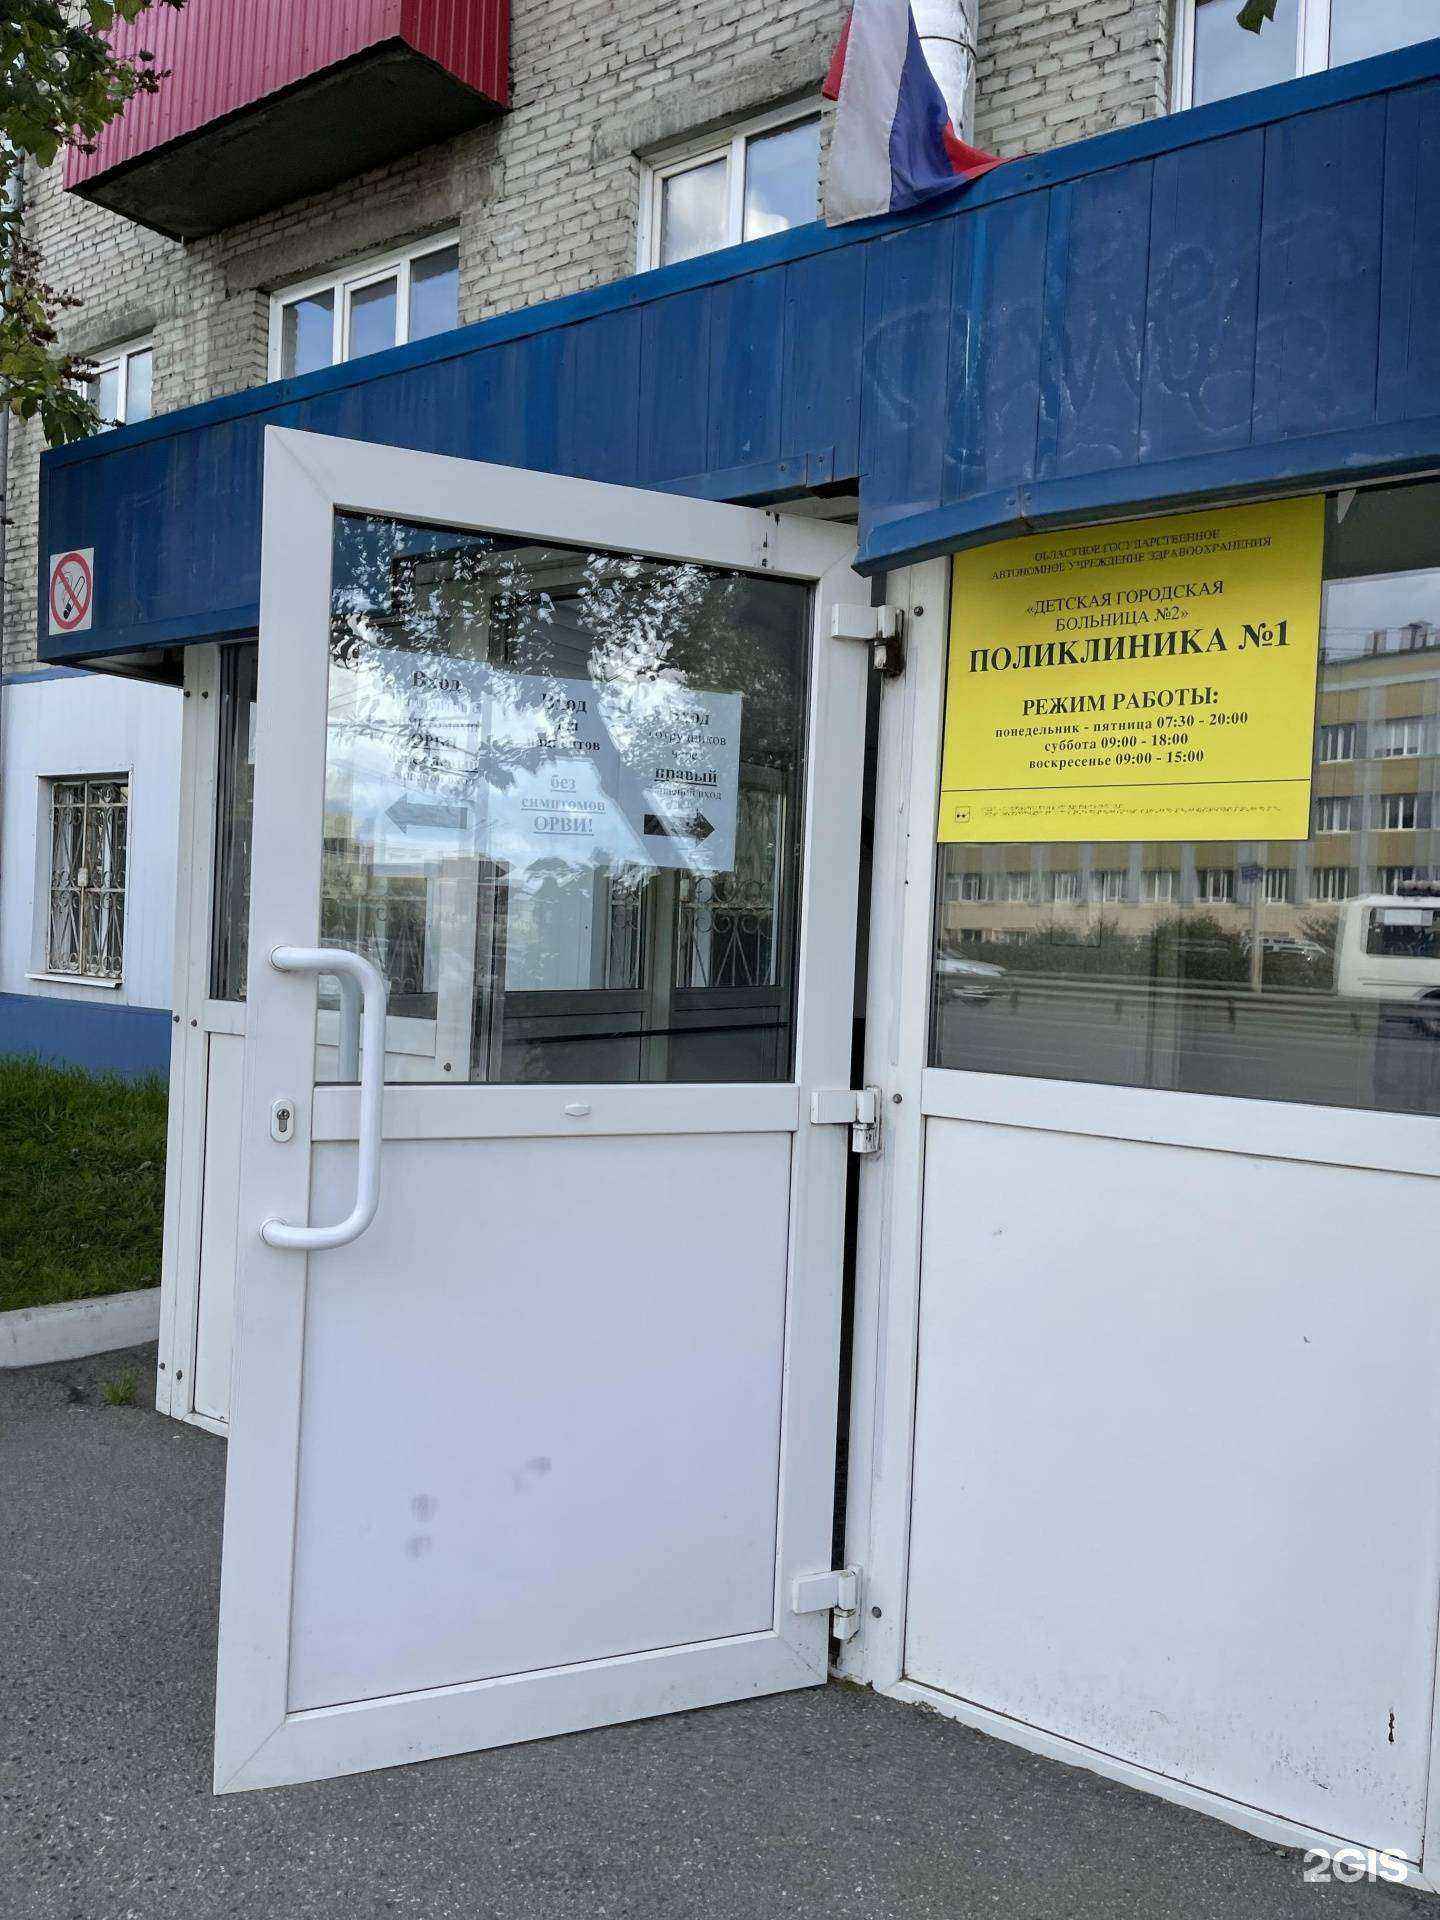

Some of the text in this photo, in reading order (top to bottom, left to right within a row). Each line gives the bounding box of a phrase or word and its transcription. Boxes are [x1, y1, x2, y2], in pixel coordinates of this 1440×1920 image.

[991, 536, 1272, 581] АВТОНОМНОЕ УЧРЕЖДЕНИЕ ЗДРАВООХРАНЕНИЯ
[1034, 529, 1220, 561] ОБЛАСТНОЕ ГОСУДАРСТВЕННОЕ
[1026, 580, 1224, 615] «ДЕТСКАЯ ГОРОДСКАЯ
[1055, 605, 1190, 633] БОЛЬНИЦА №2»
[968, 619, 1291, 673] ПОЛИКЛИНИКА №1
[1022, 686, 1219, 717] РЕЖИМ РАБОТЫ:
[995, 723, 1080, 739] понедельник
[1093, 719, 1152, 734] пятница
[1156, 715, 1195, 729] 07:30
[1209, 711, 1249, 726] 20:00
[1044, 737, 1097, 753] суббота
[1101, 735, 1138, 750] 09:00
[1151, 732, 1189, 747] 18:00
[1029, 757, 1112, 771] воскресенье
[1115, 752, 1152, 767] 09:00
[1166, 749, 1204, 764] 15:00
[550, 774, 577, 790] без
[655, 767, 718, 784] правый
[521, 797, 606, 812] симптомов
[533, 815, 594, 833] ОРВИ!
